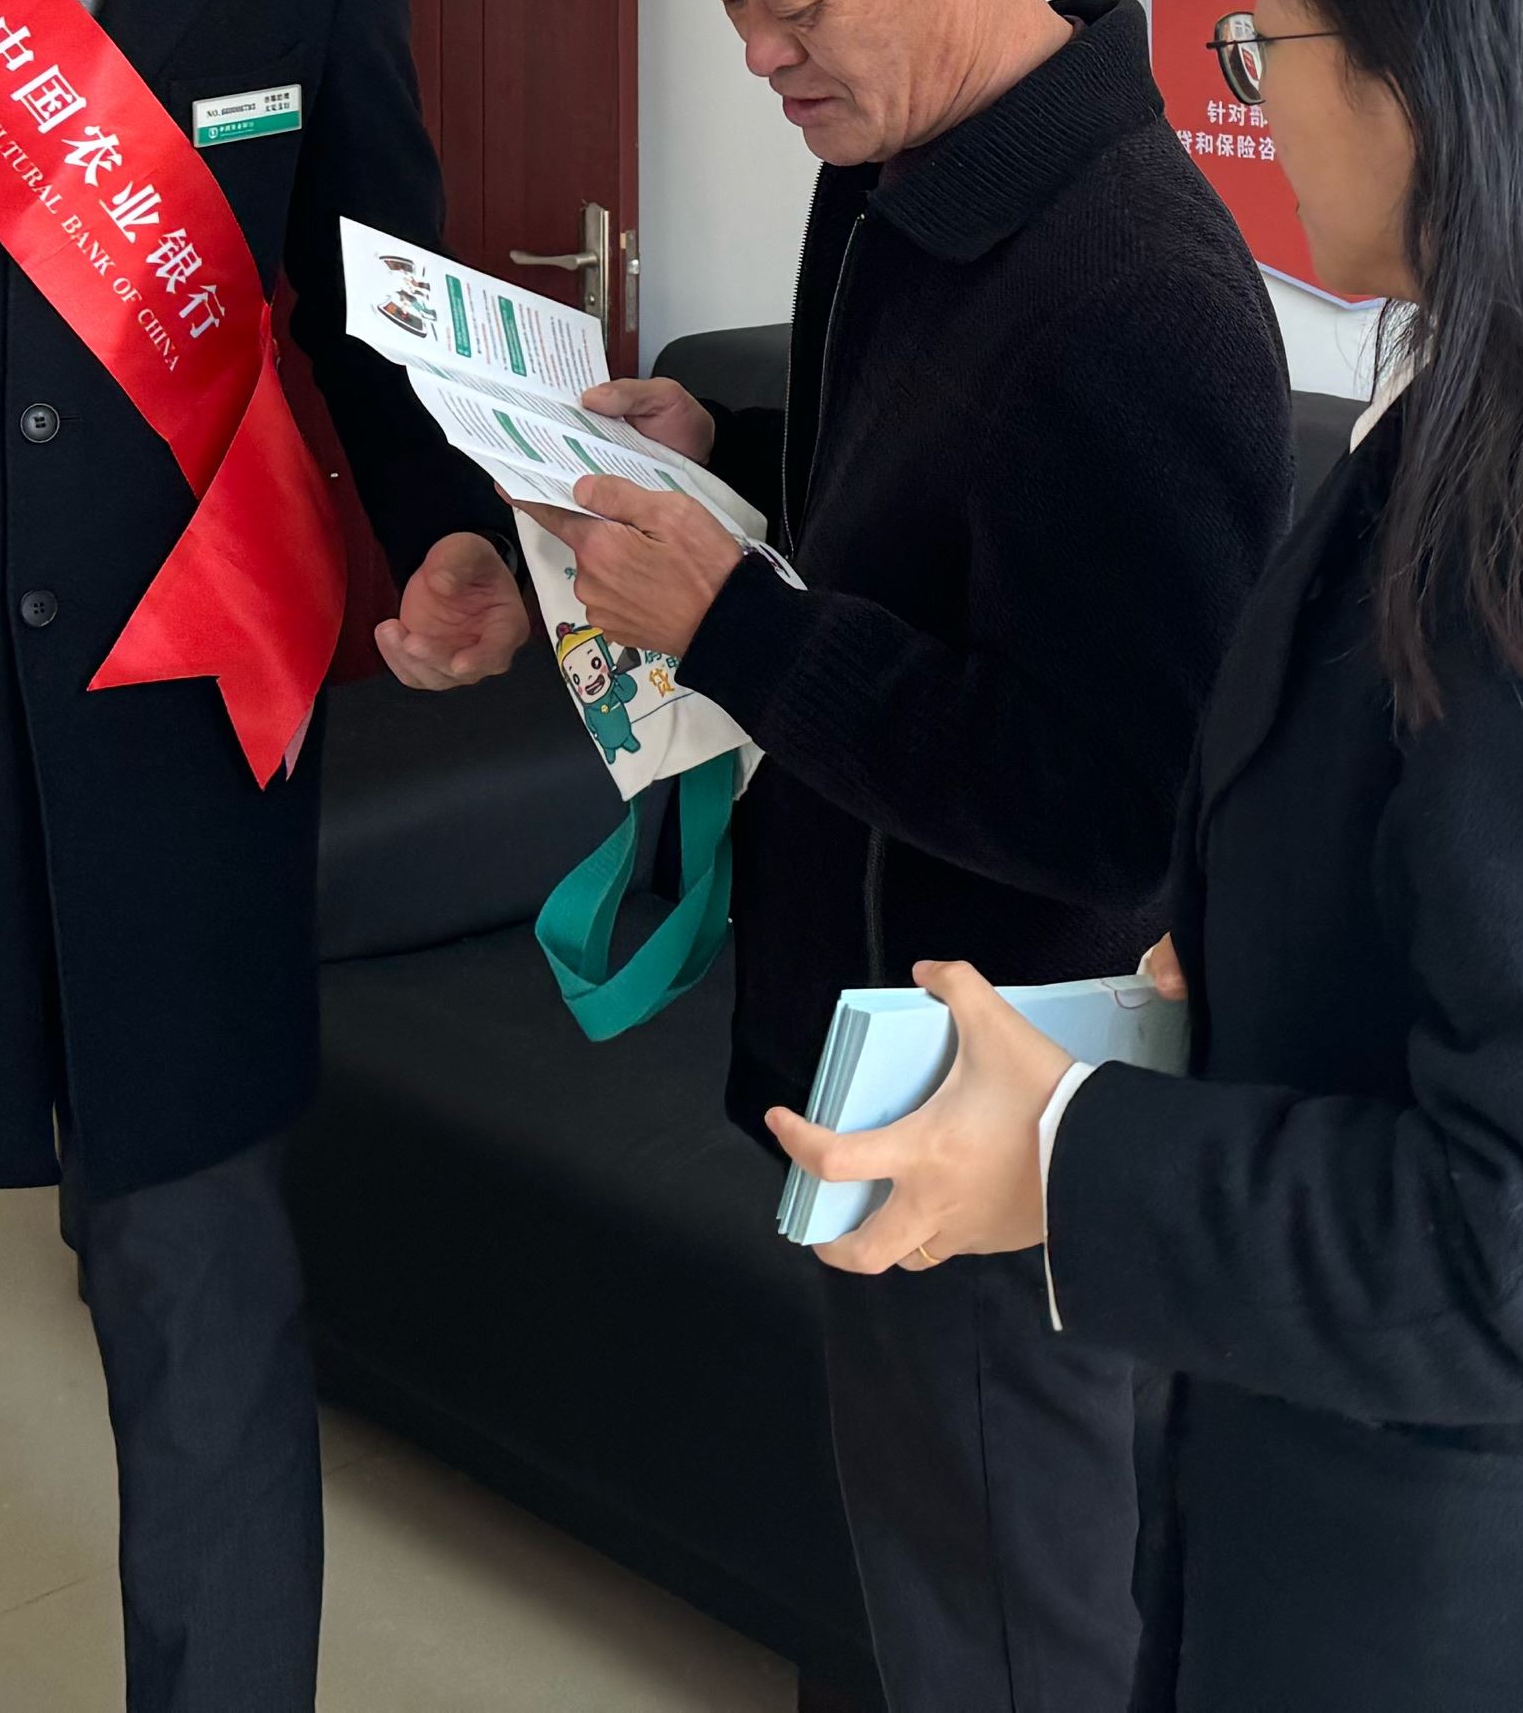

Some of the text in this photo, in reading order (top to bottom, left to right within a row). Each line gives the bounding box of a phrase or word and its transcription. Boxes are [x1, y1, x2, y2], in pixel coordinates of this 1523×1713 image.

[63, 216, 115, 277] BANK
[114, 276, 142, 304] OF
[138, 308, 180, 371] CHINA
